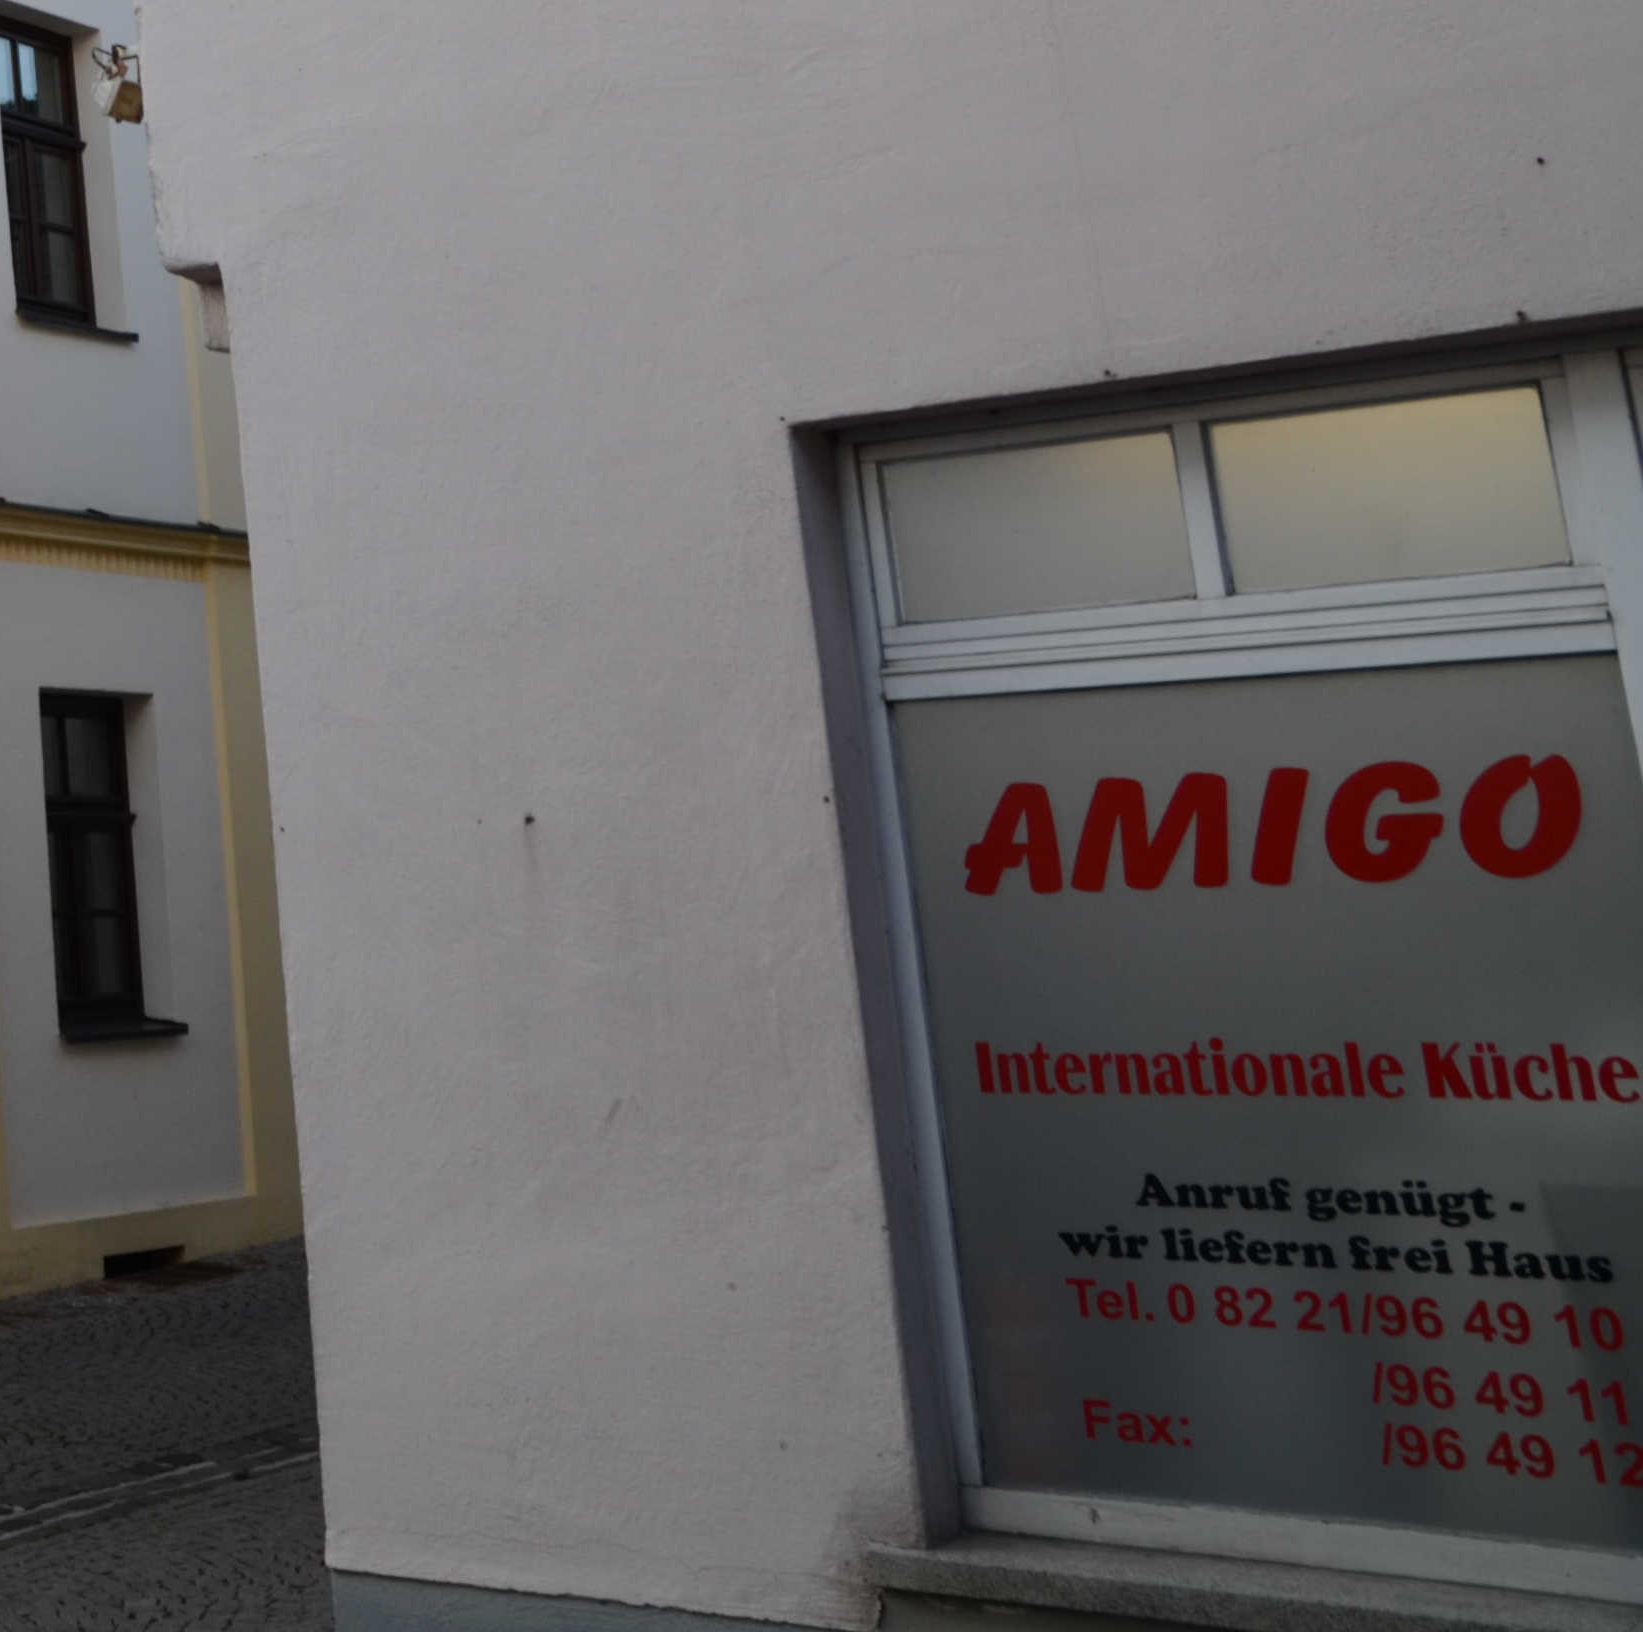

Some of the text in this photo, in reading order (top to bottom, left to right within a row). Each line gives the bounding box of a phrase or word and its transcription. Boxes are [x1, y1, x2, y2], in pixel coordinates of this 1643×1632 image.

[965, 754, 1583, 895] AMIGO
[976, 1037, 1641, 1103] Internationale Küche
[1136, 1173, 1292, 1213] Anruf
[1305, 1180, 1496, 1227] genügt
[1058, 1224, 1615, 1285] wir liefern frei Haus
[1065, 1277, 1625, 1352] Tel. 0 82 21/96 49 10
[1372, 1361, 1631, 1427] /96 49 11
[1082, 1399, 1643, 1487] Fax: /96 49 12
